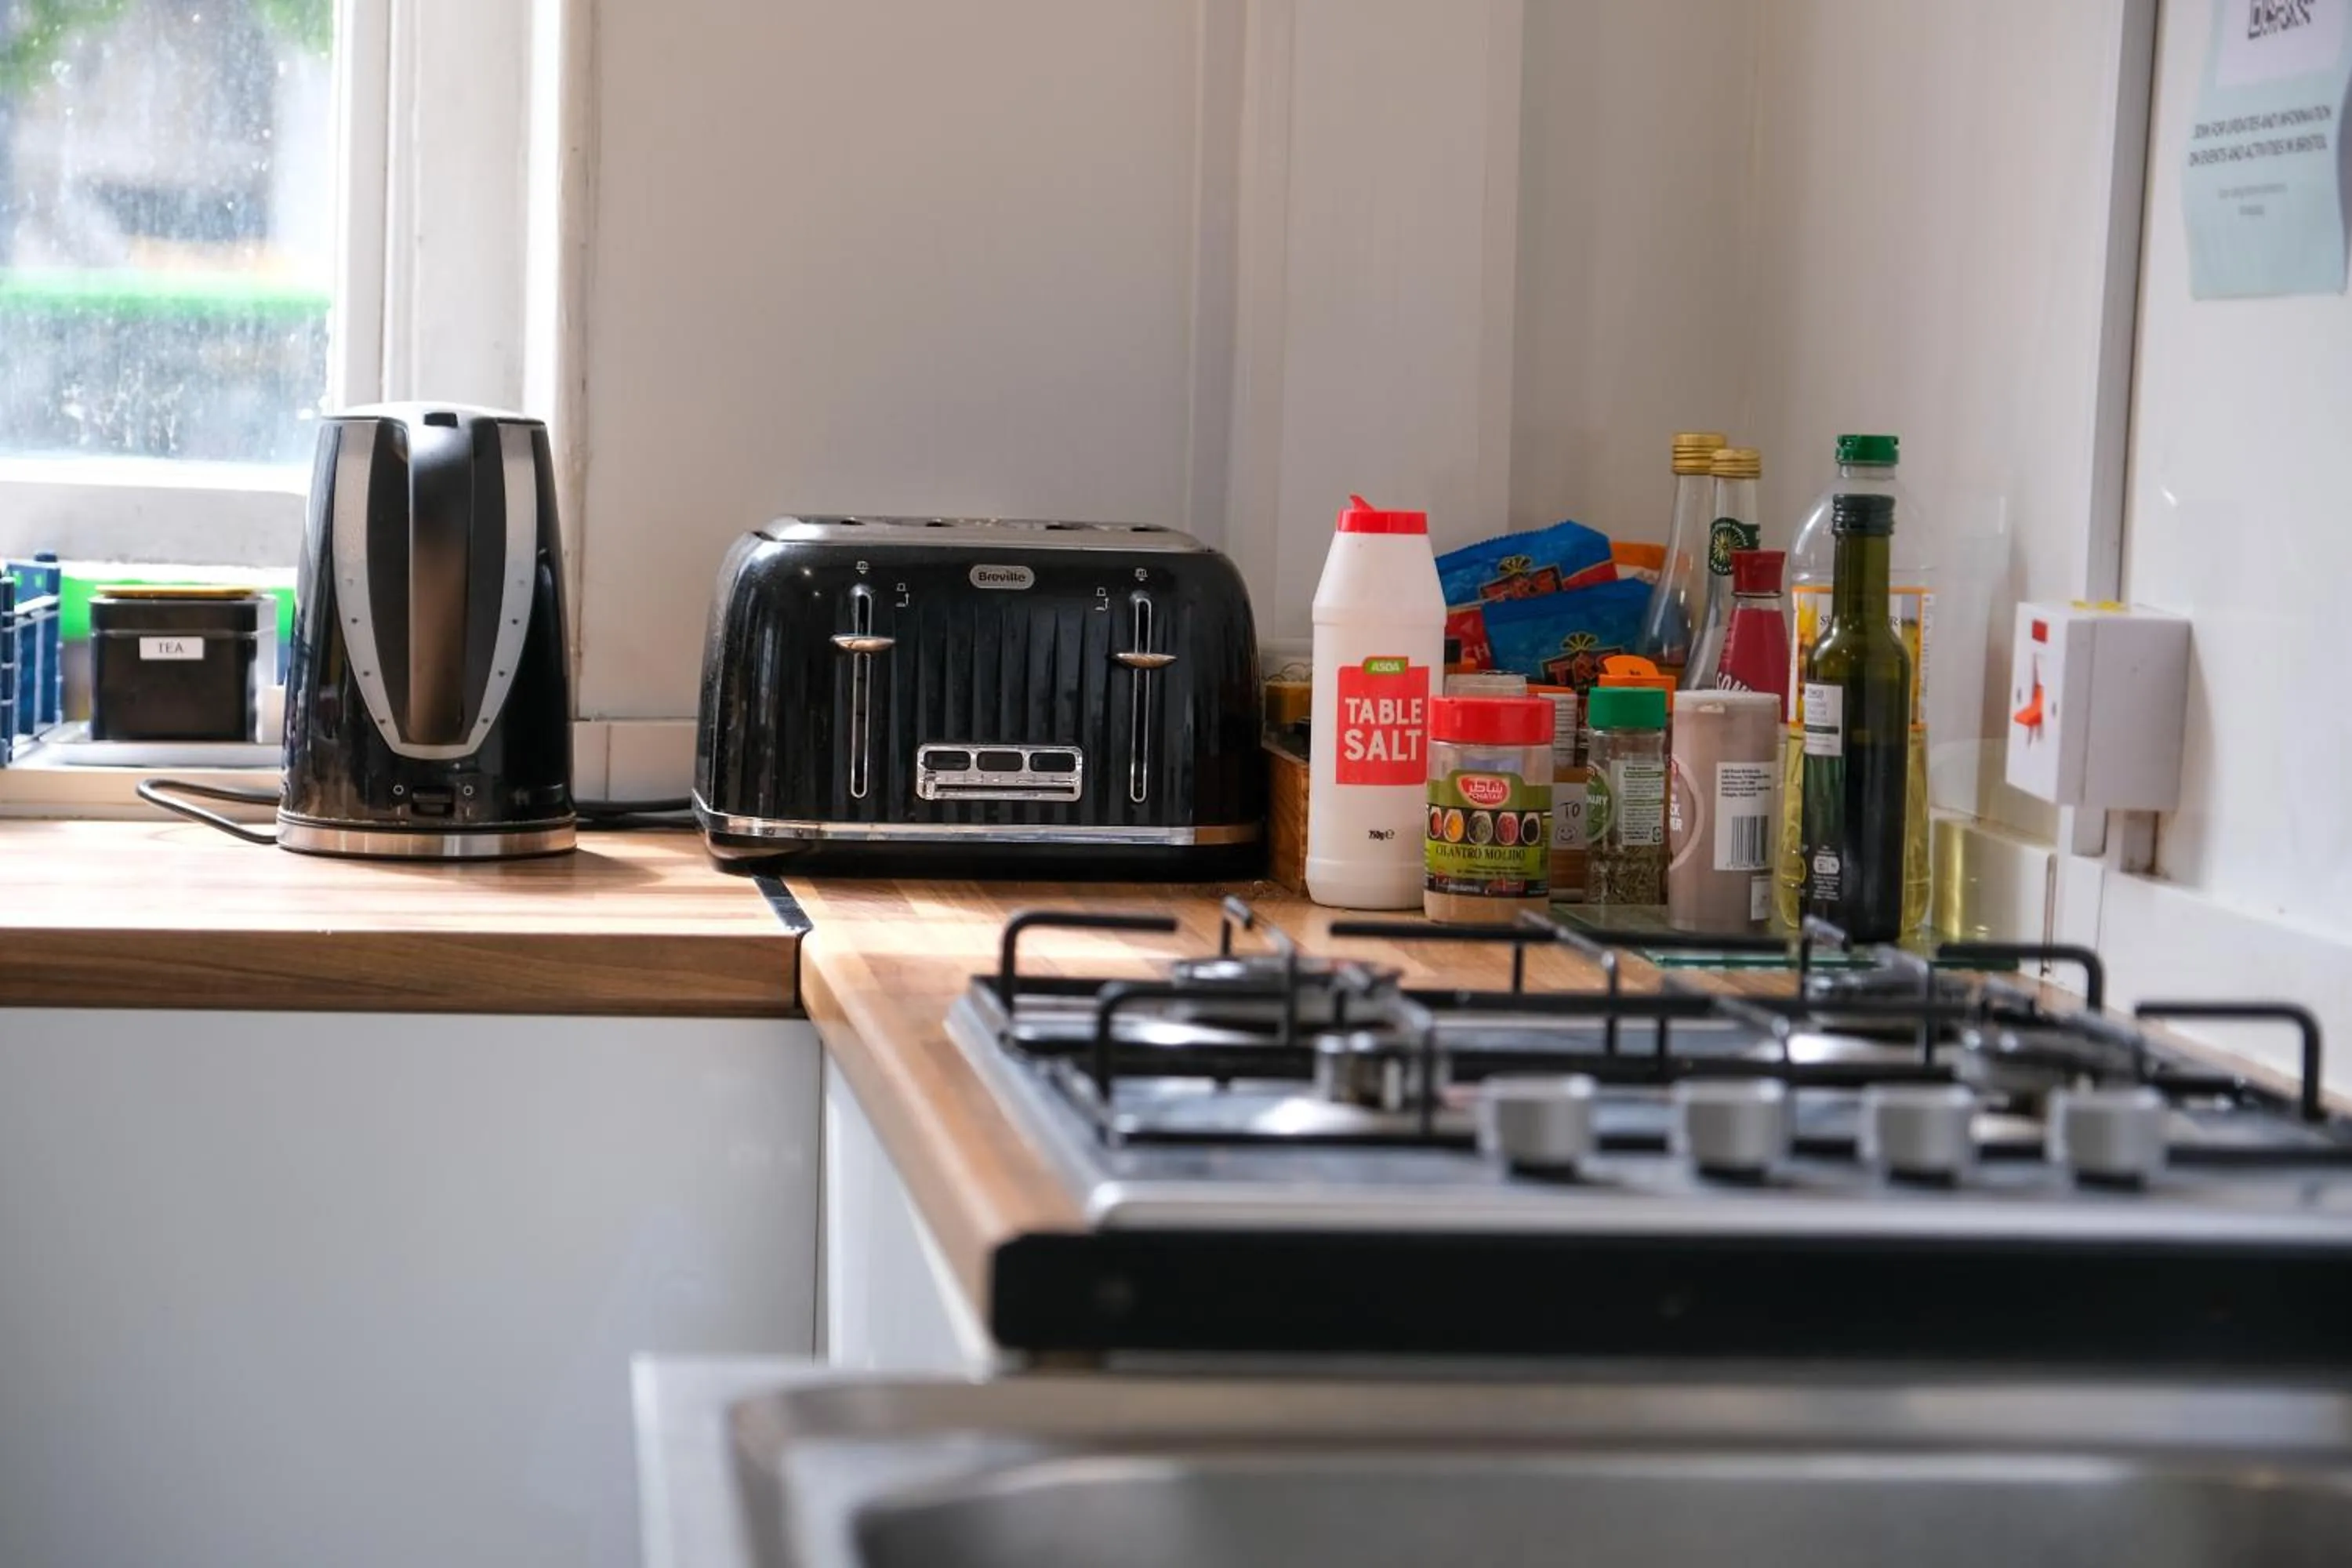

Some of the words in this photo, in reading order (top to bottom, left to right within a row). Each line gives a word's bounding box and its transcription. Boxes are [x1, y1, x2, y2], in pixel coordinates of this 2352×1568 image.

[978, 572, 1026, 582] Breville
[158, 641, 184, 653] TEA
[1370, 661, 1400, 672] ASDA
[1345, 697, 1423, 725] TABLE
[1344, 728, 1422, 761] SALT
[1436, 844, 1481, 860] CILANTRO
[1484, 848, 1526, 861] MOLIDO
